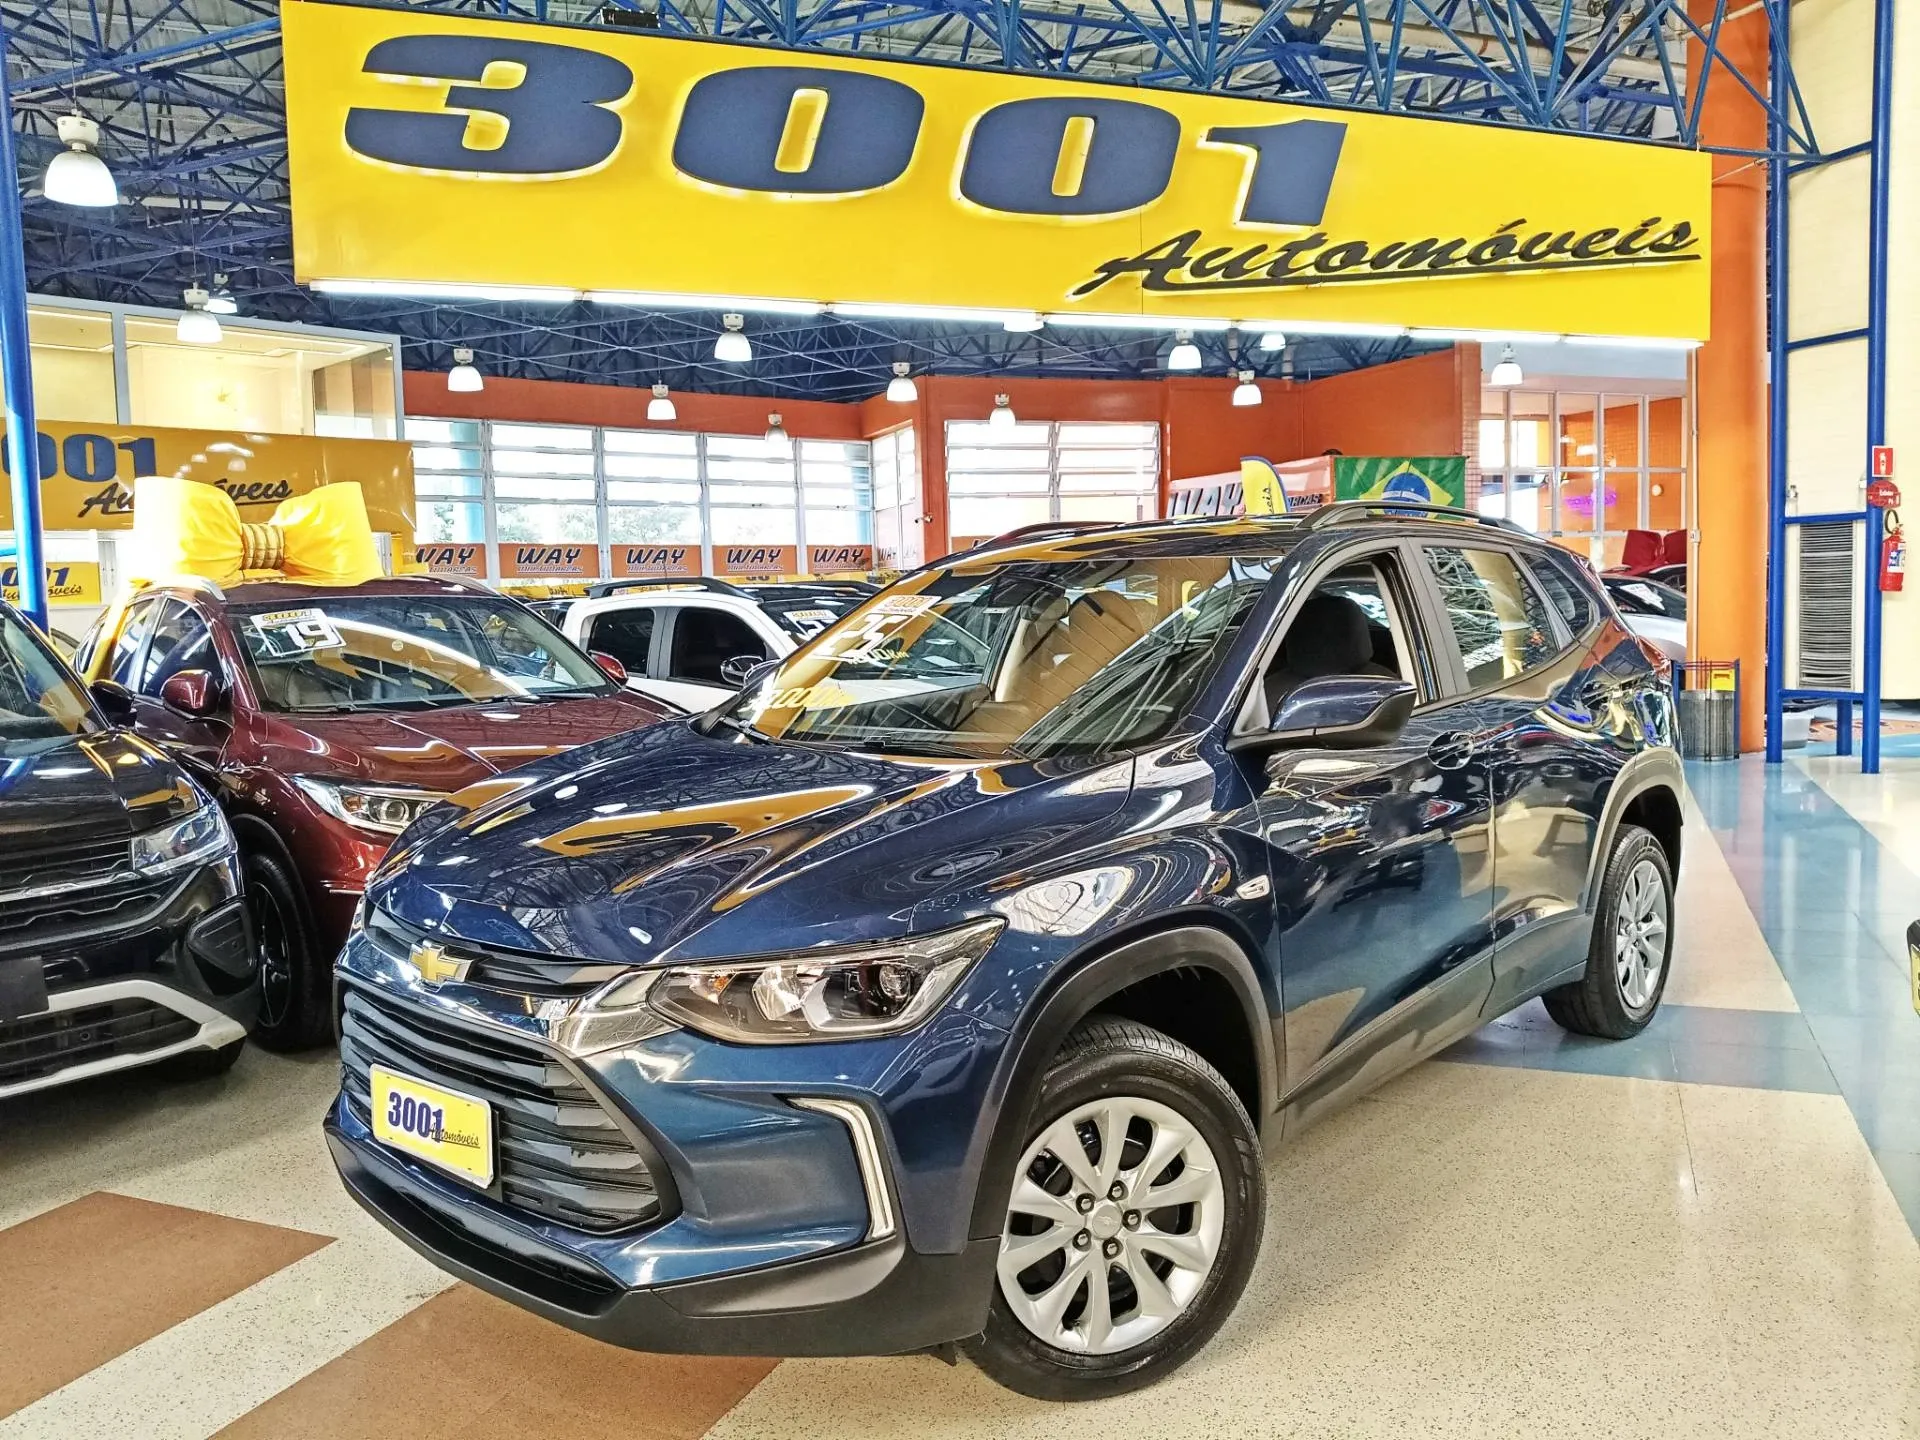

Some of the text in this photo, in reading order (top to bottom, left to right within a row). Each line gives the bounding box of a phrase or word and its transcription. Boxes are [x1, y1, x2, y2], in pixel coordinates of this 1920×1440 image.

[345, 34, 1348, 226] 3001
[1066, 216, 1701, 297] Automóveis
[516, 548, 581, 564] WAY
[626, 548, 686, 564] WAY
[727, 548, 782, 564] WAY
[814, 548, 864, 564] WAY
[285, 620, 341, 652] 19
[388, 1091, 444, 1143] 3001
